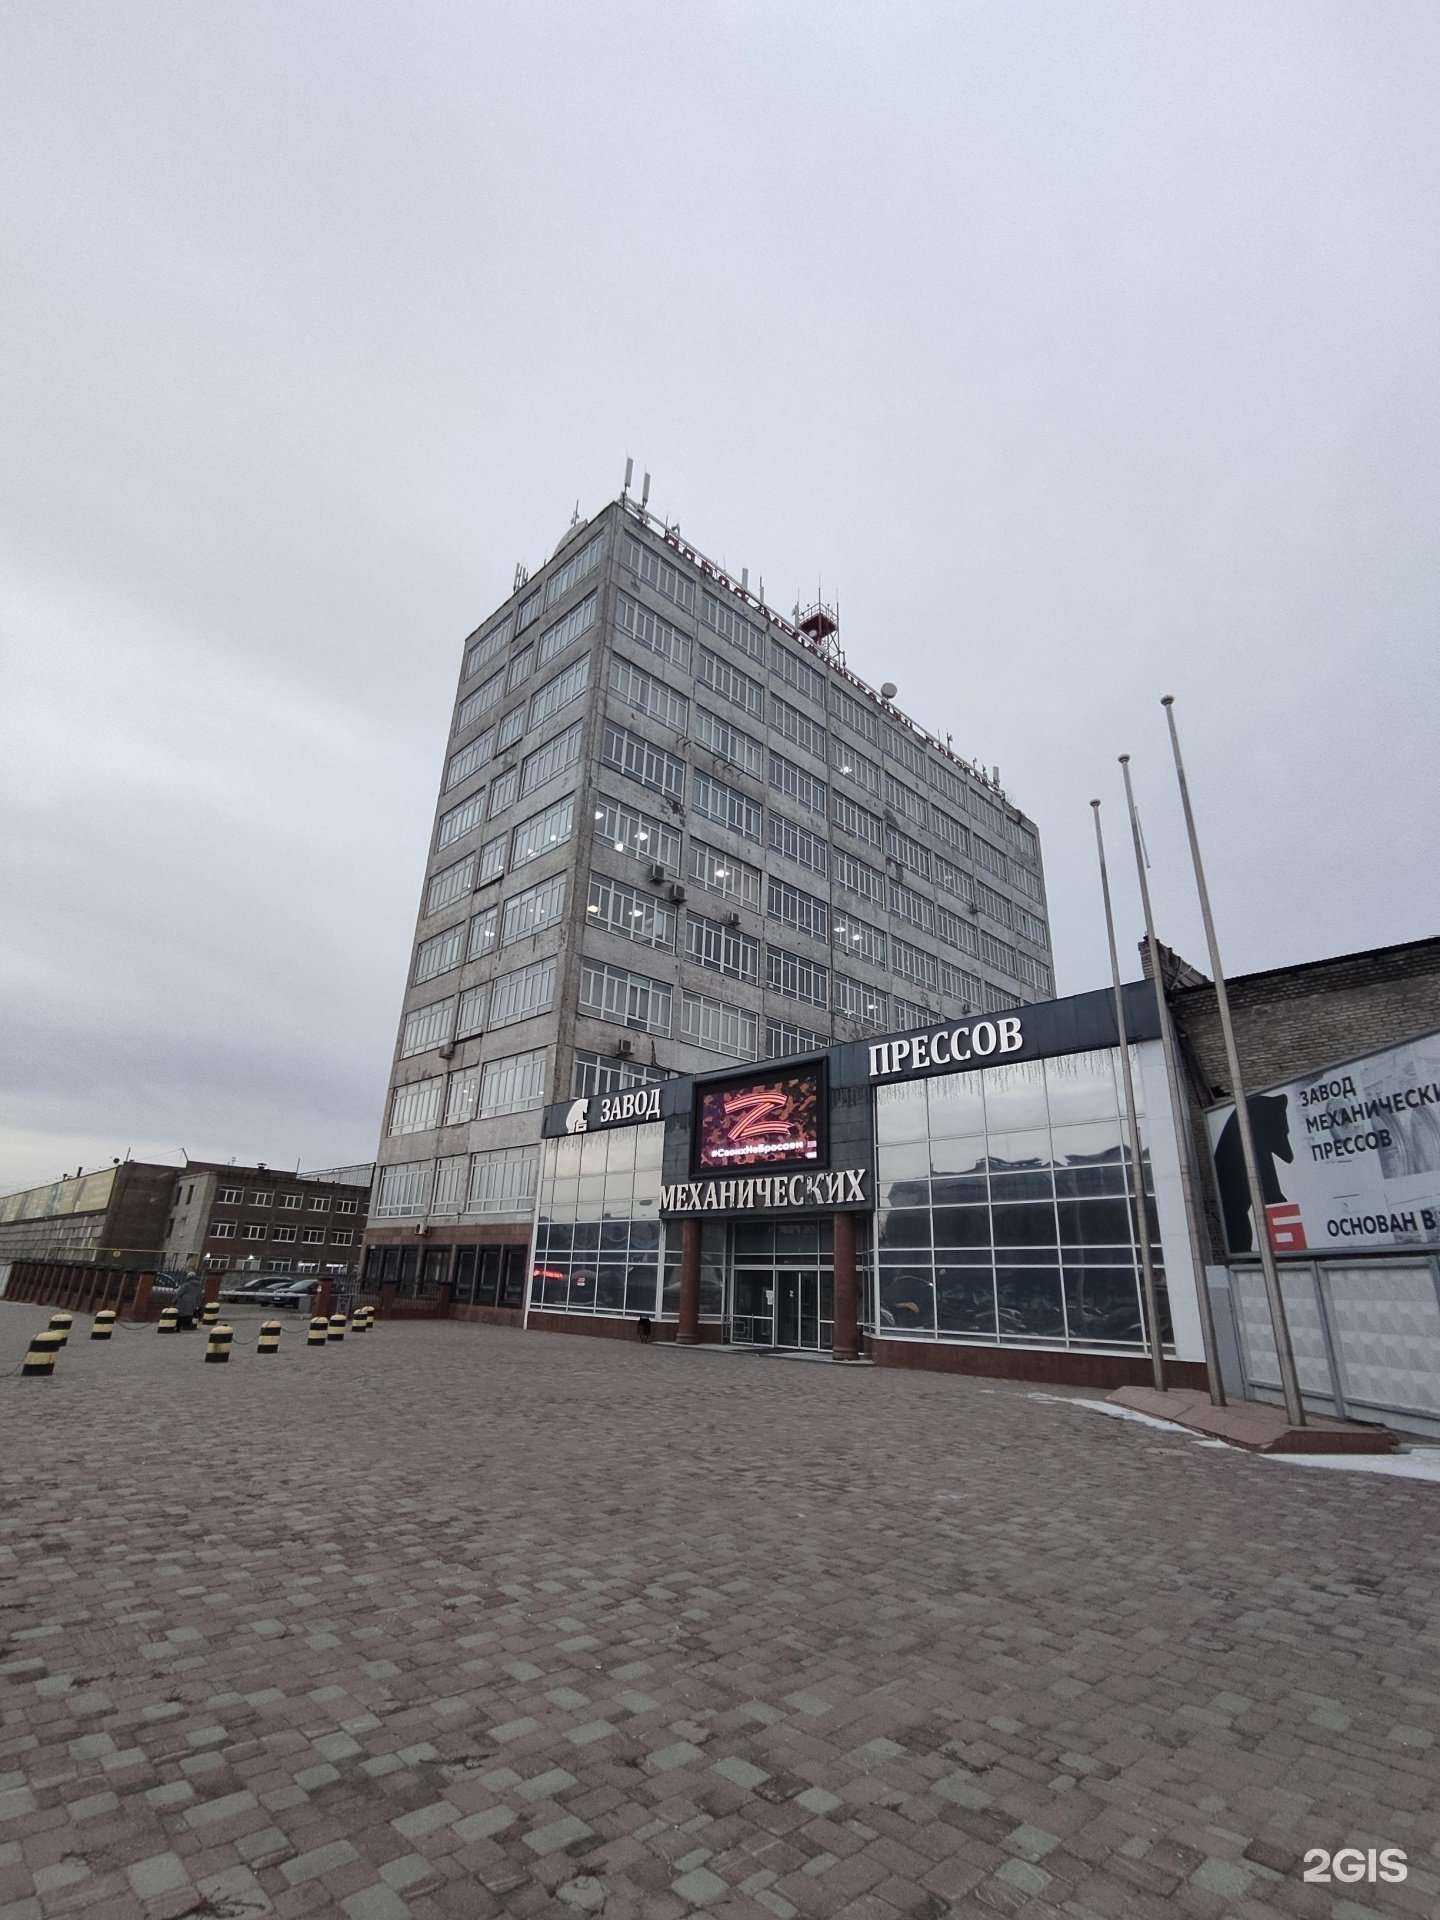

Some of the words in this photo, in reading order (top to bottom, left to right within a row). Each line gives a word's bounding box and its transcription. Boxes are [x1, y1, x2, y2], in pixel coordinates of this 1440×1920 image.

[869, 1017, 1023, 1076] ПРЕССОВ
[600, 1088, 661, 1122] ЗАВОД
[1300, 1076, 1357, 1107] ЗАВОД
[1312, 1129, 1392, 1161] ПРЕССОВ
[660, 1168, 866, 1211] МЕХАНИЧЕСКИХ
[1327, 1211, 1418, 1237] ОСНОВАН
[1421, 1209, 1436, 1230] В
